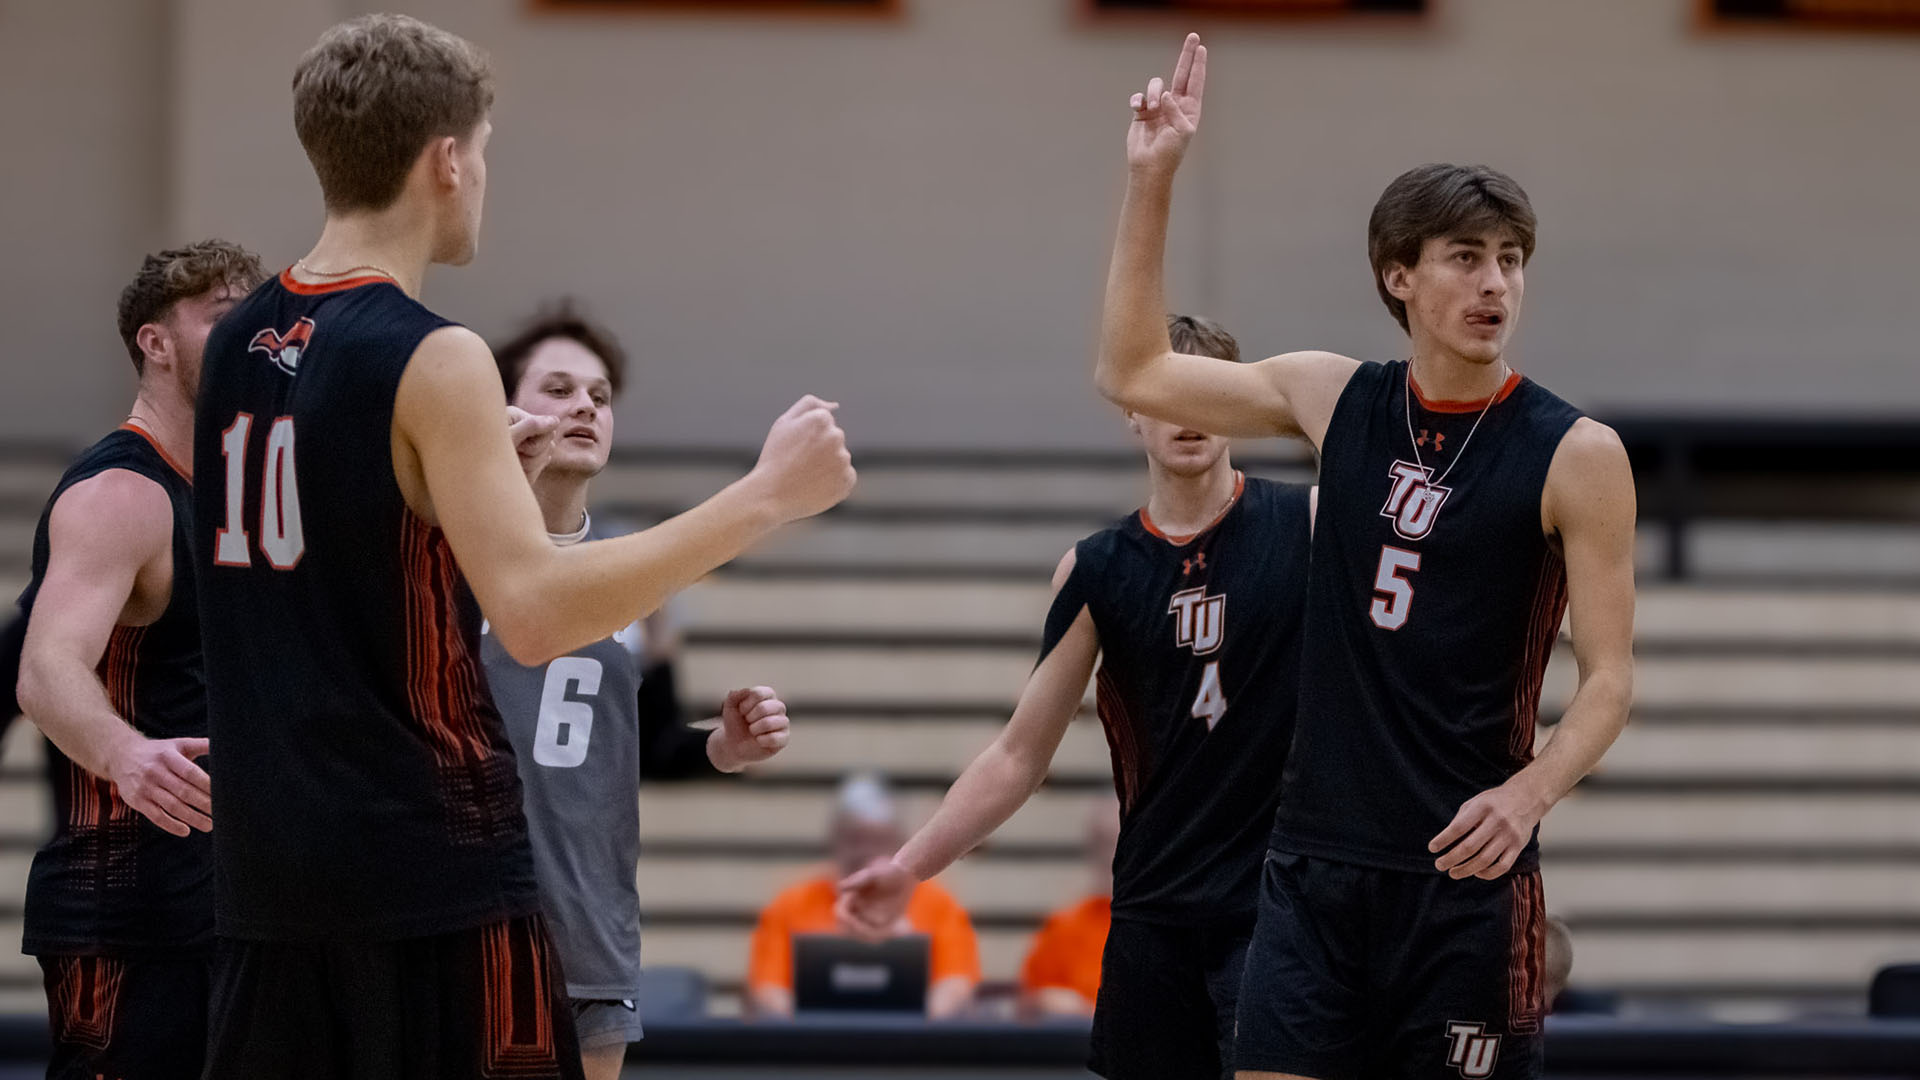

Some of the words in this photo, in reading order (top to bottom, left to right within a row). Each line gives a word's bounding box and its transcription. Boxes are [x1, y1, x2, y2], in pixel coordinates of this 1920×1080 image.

[213, 411, 304, 571] 10
[1380, 458, 1453, 541] TU
[1167, 585, 1227, 656] TU
[1369, 544, 1422, 631] 5
[533, 656, 603, 768] 6
[1190, 660, 1228, 732] 4
[1444, 1020, 1502, 1080] TU
